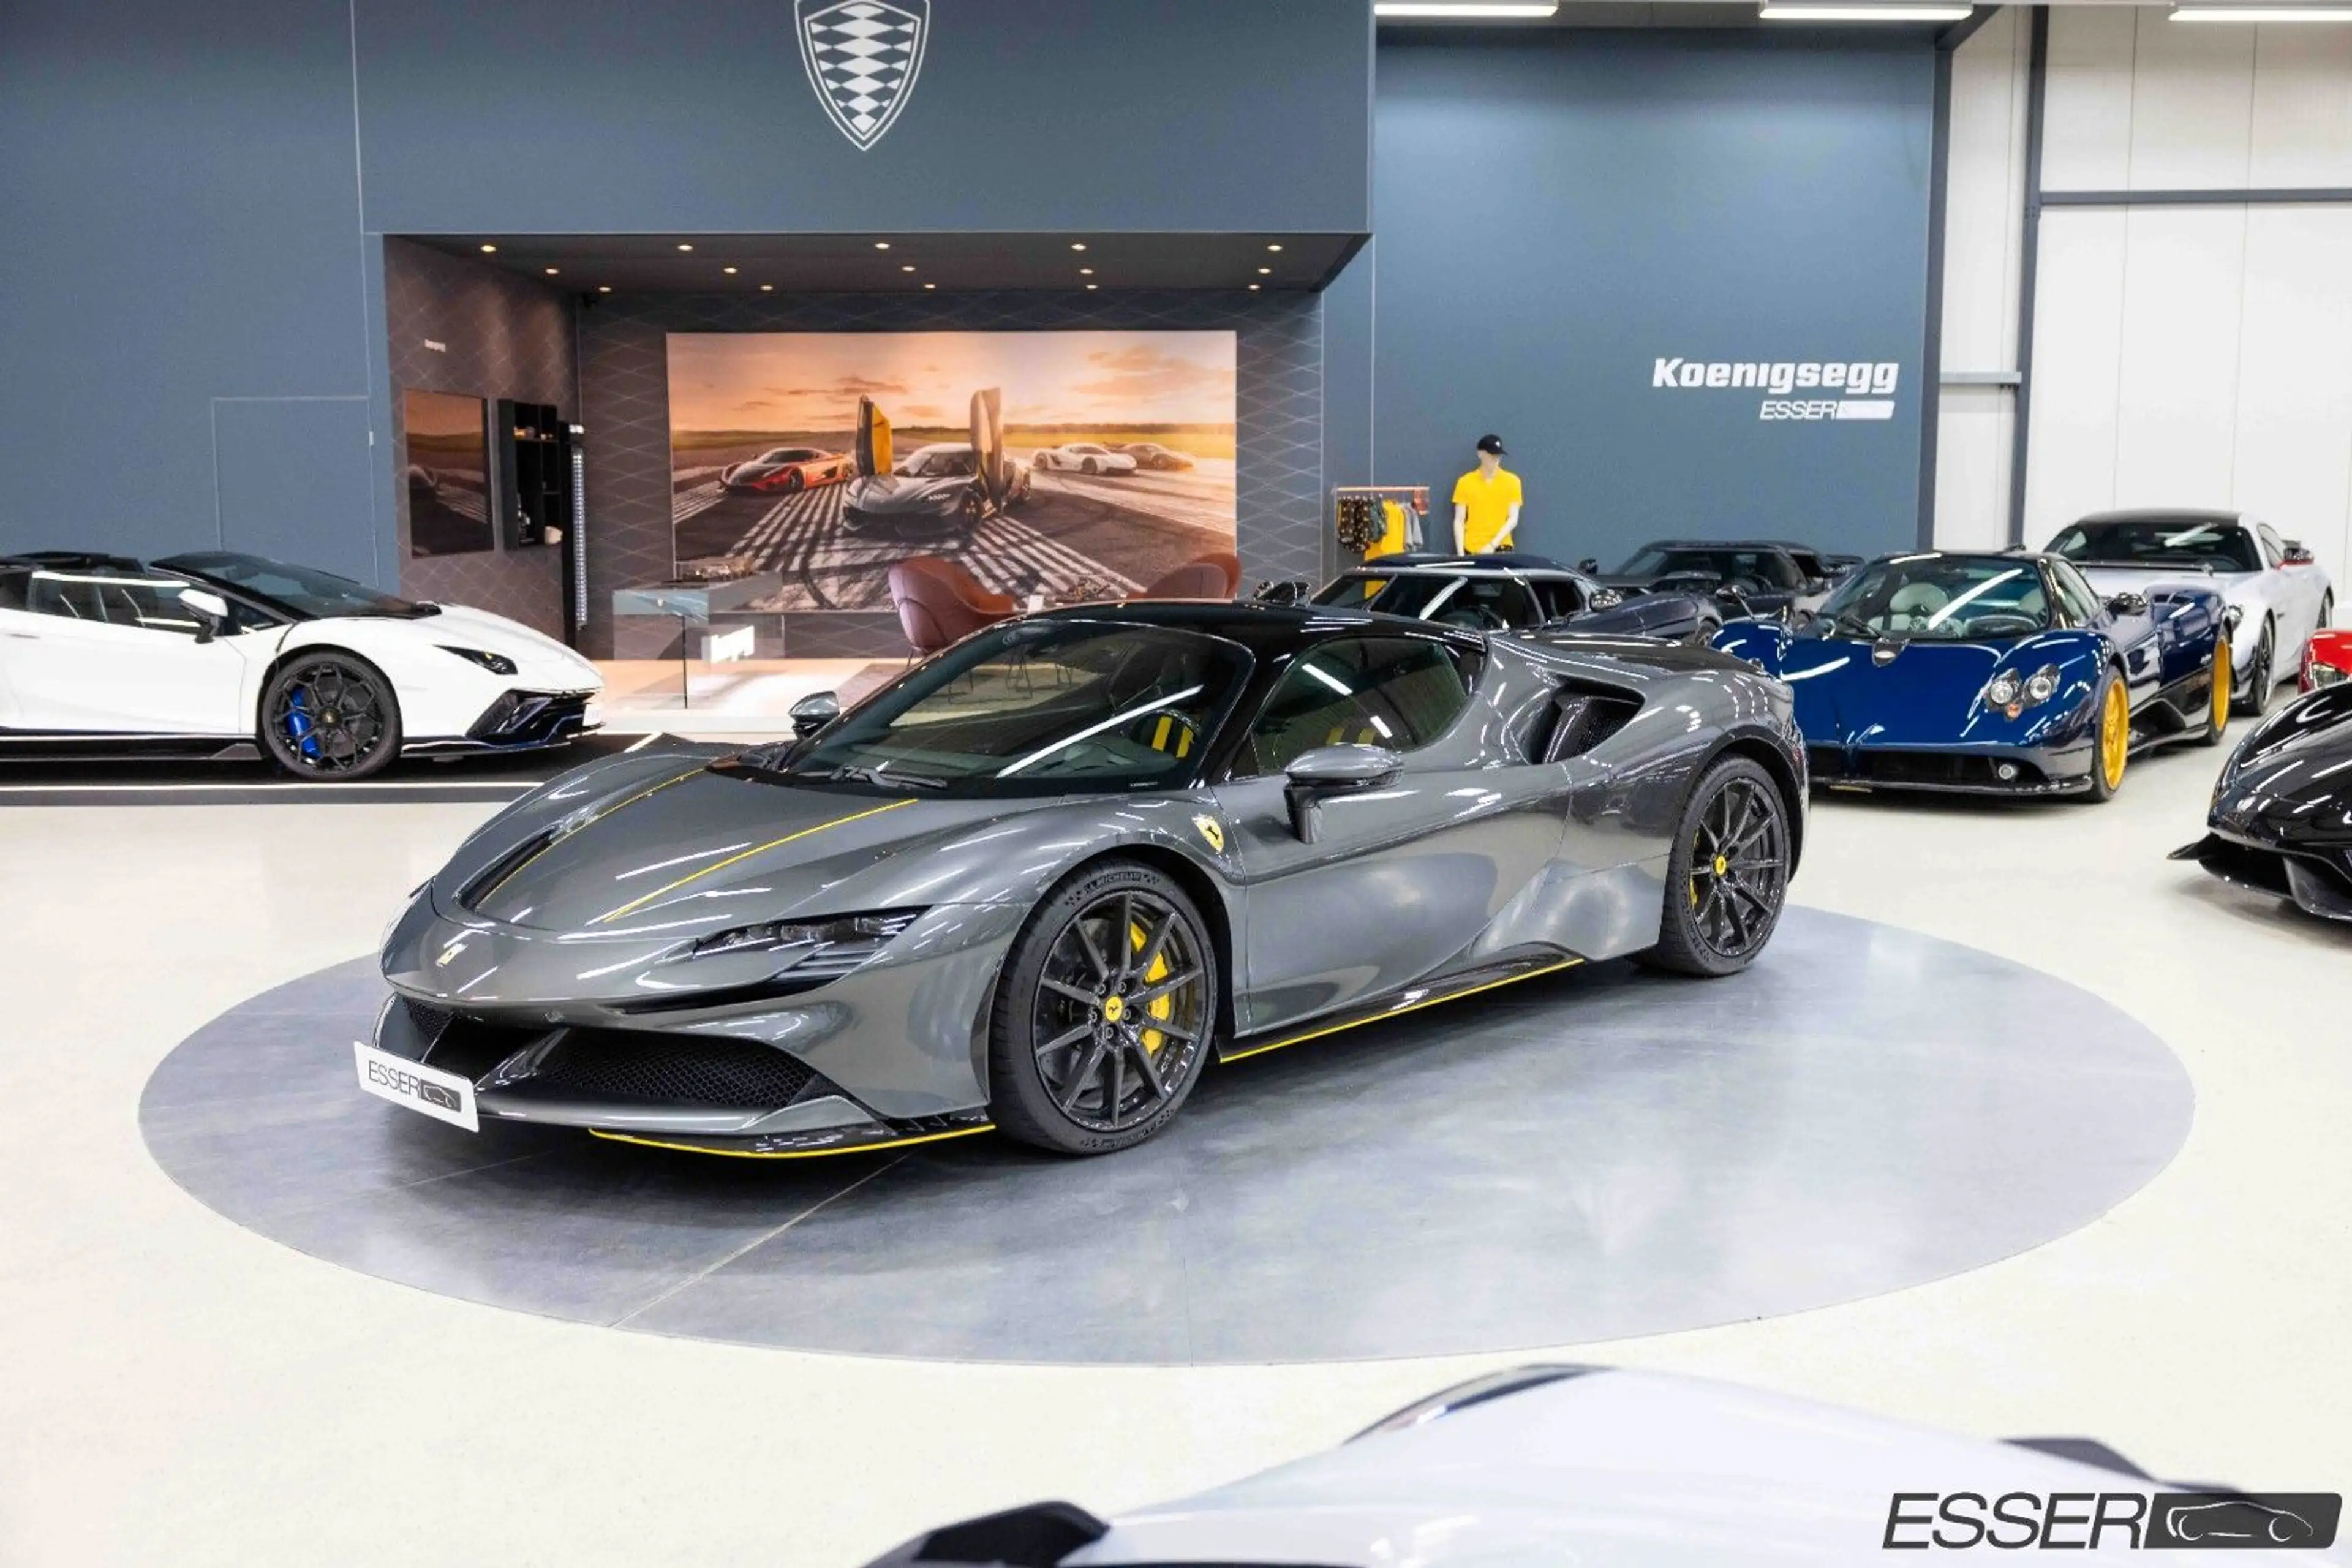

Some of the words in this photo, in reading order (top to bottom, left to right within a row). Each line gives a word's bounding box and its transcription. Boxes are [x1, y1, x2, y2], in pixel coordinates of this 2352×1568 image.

[1653, 358, 1898, 394] Koenigsegg
[1760, 401, 1837, 420] ESSER
[369, 1060, 420, 1097] ESSER
